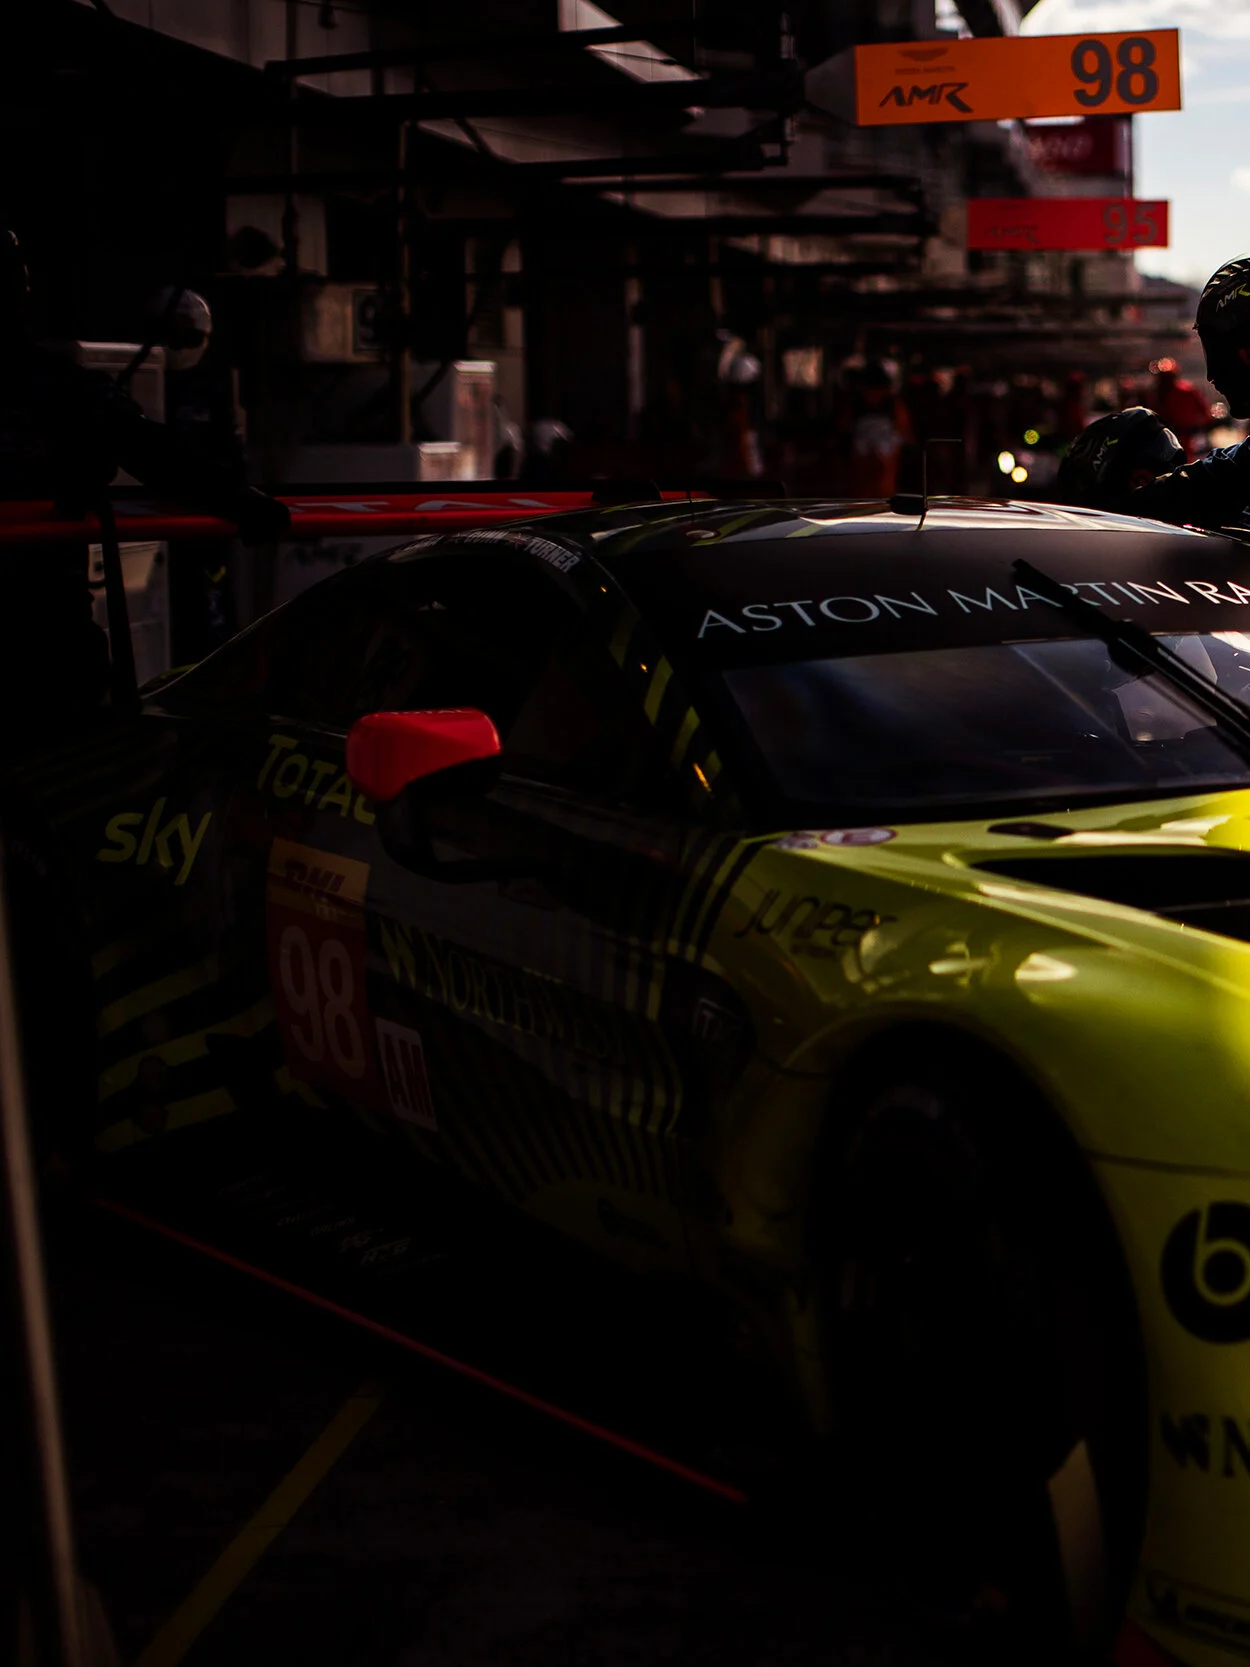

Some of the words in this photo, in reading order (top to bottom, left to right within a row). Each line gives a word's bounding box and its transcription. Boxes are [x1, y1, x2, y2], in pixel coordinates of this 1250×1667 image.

[878, 82, 974, 113] AMR
[1070, 36, 1160, 107] 98
[1102, 203, 1159, 245] 95
[523, 535, 582, 574] TURNER
[696, 591, 940, 640] ASTON
[946, 578, 1191, 618] MARTIN
[256, 733, 377, 826] TOTAL
[94, 796, 214, 888] sky
[279, 925, 367, 1080] 98
